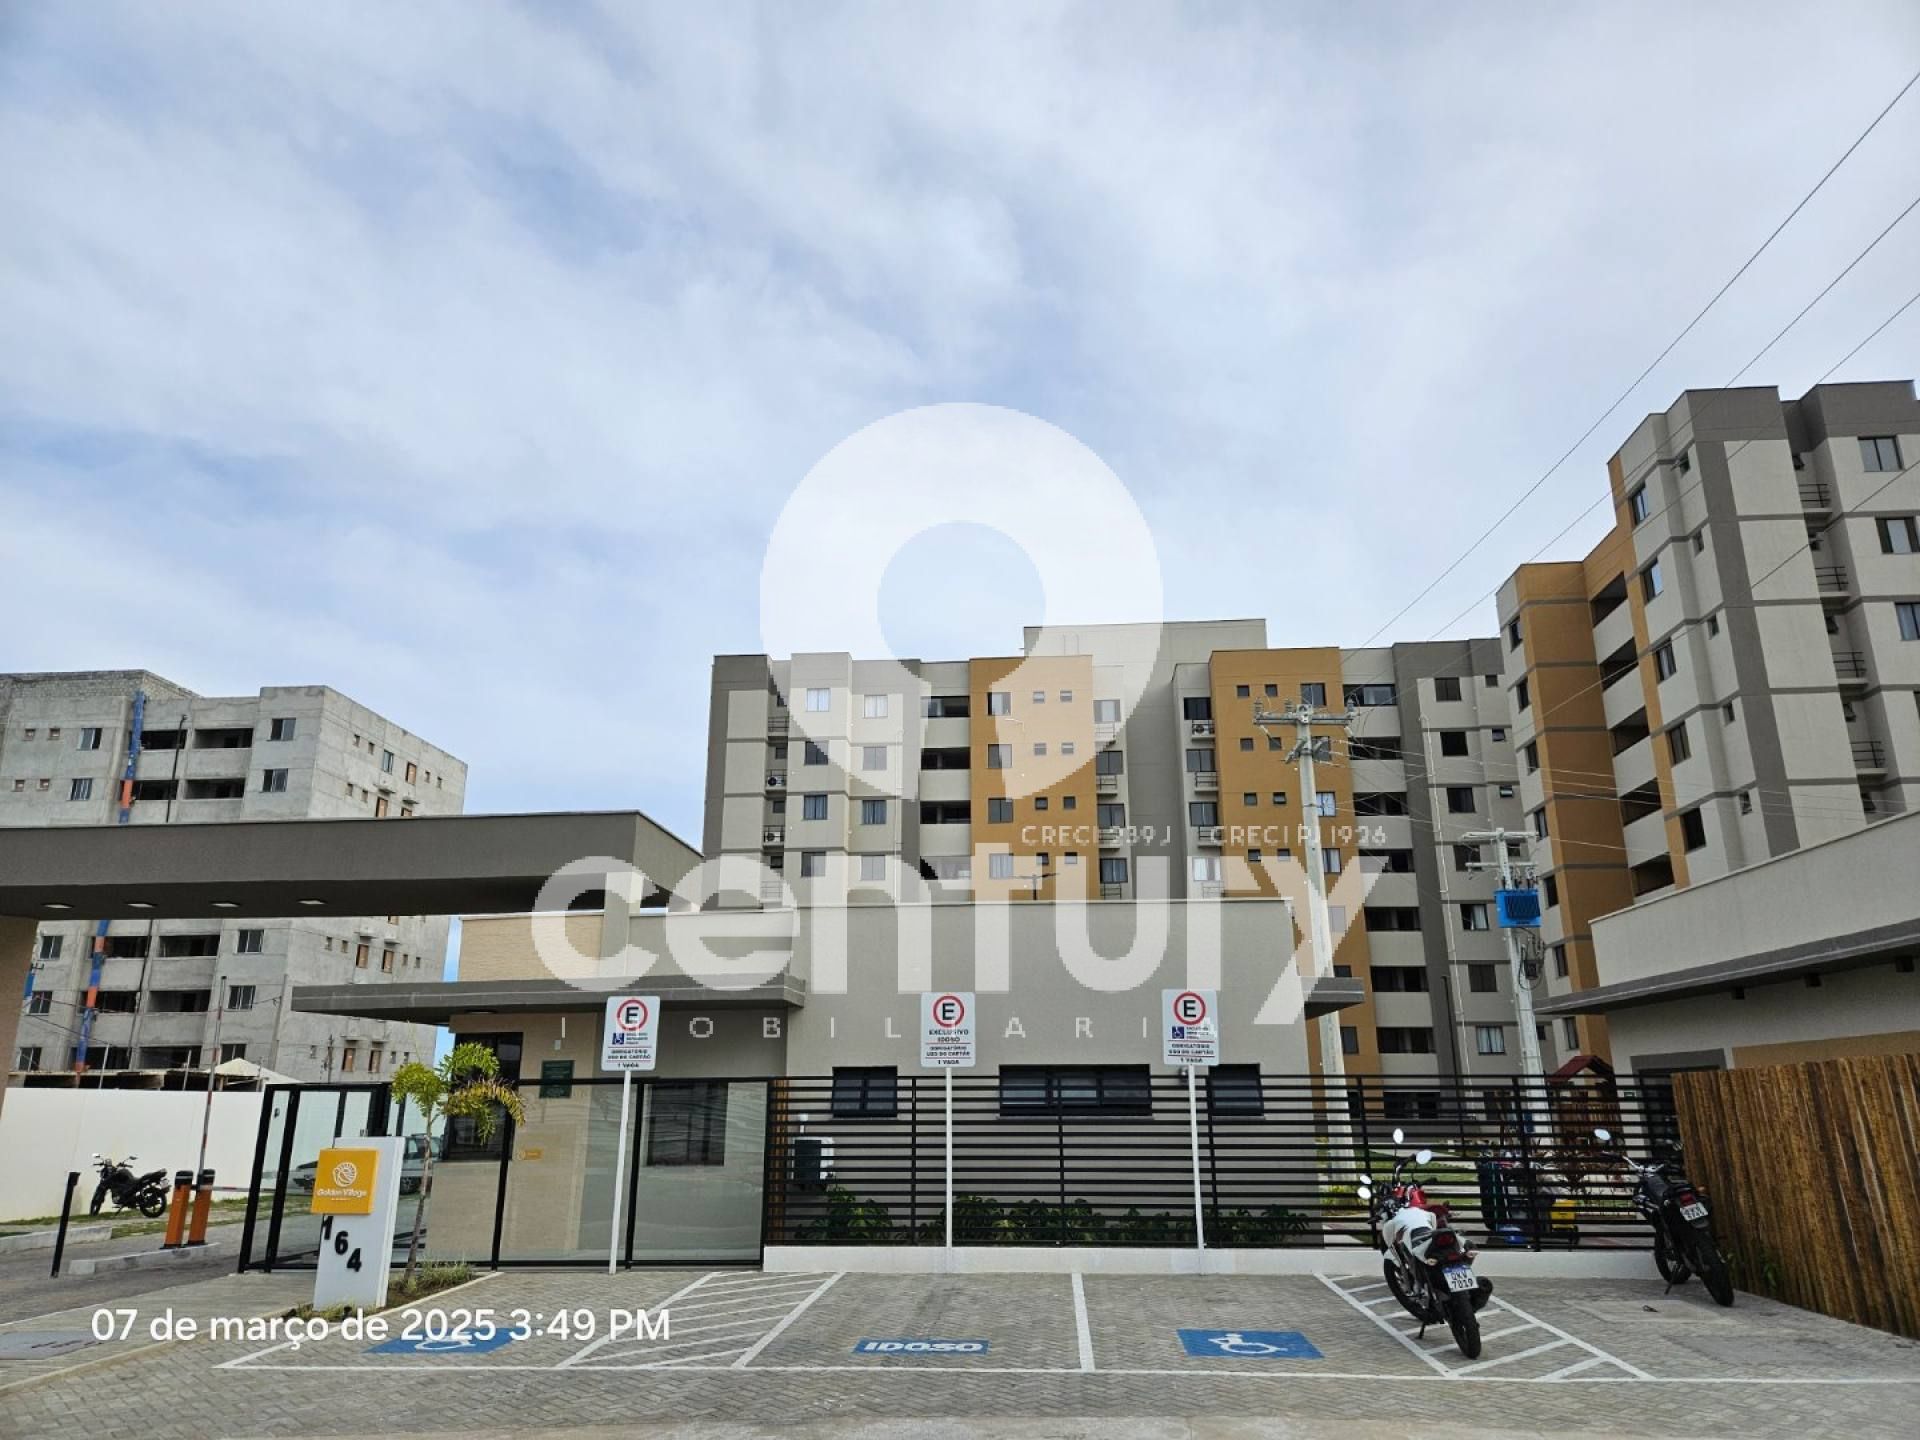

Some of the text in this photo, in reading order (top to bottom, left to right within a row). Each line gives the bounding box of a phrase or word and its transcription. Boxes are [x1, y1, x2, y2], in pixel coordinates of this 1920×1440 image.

[942, 1002, 956, 1021] E
[1183, 999, 1197, 1018] E
[322, 1214, 362, 1272] 164
[863, 1341, 984, 1352] IDOSO
